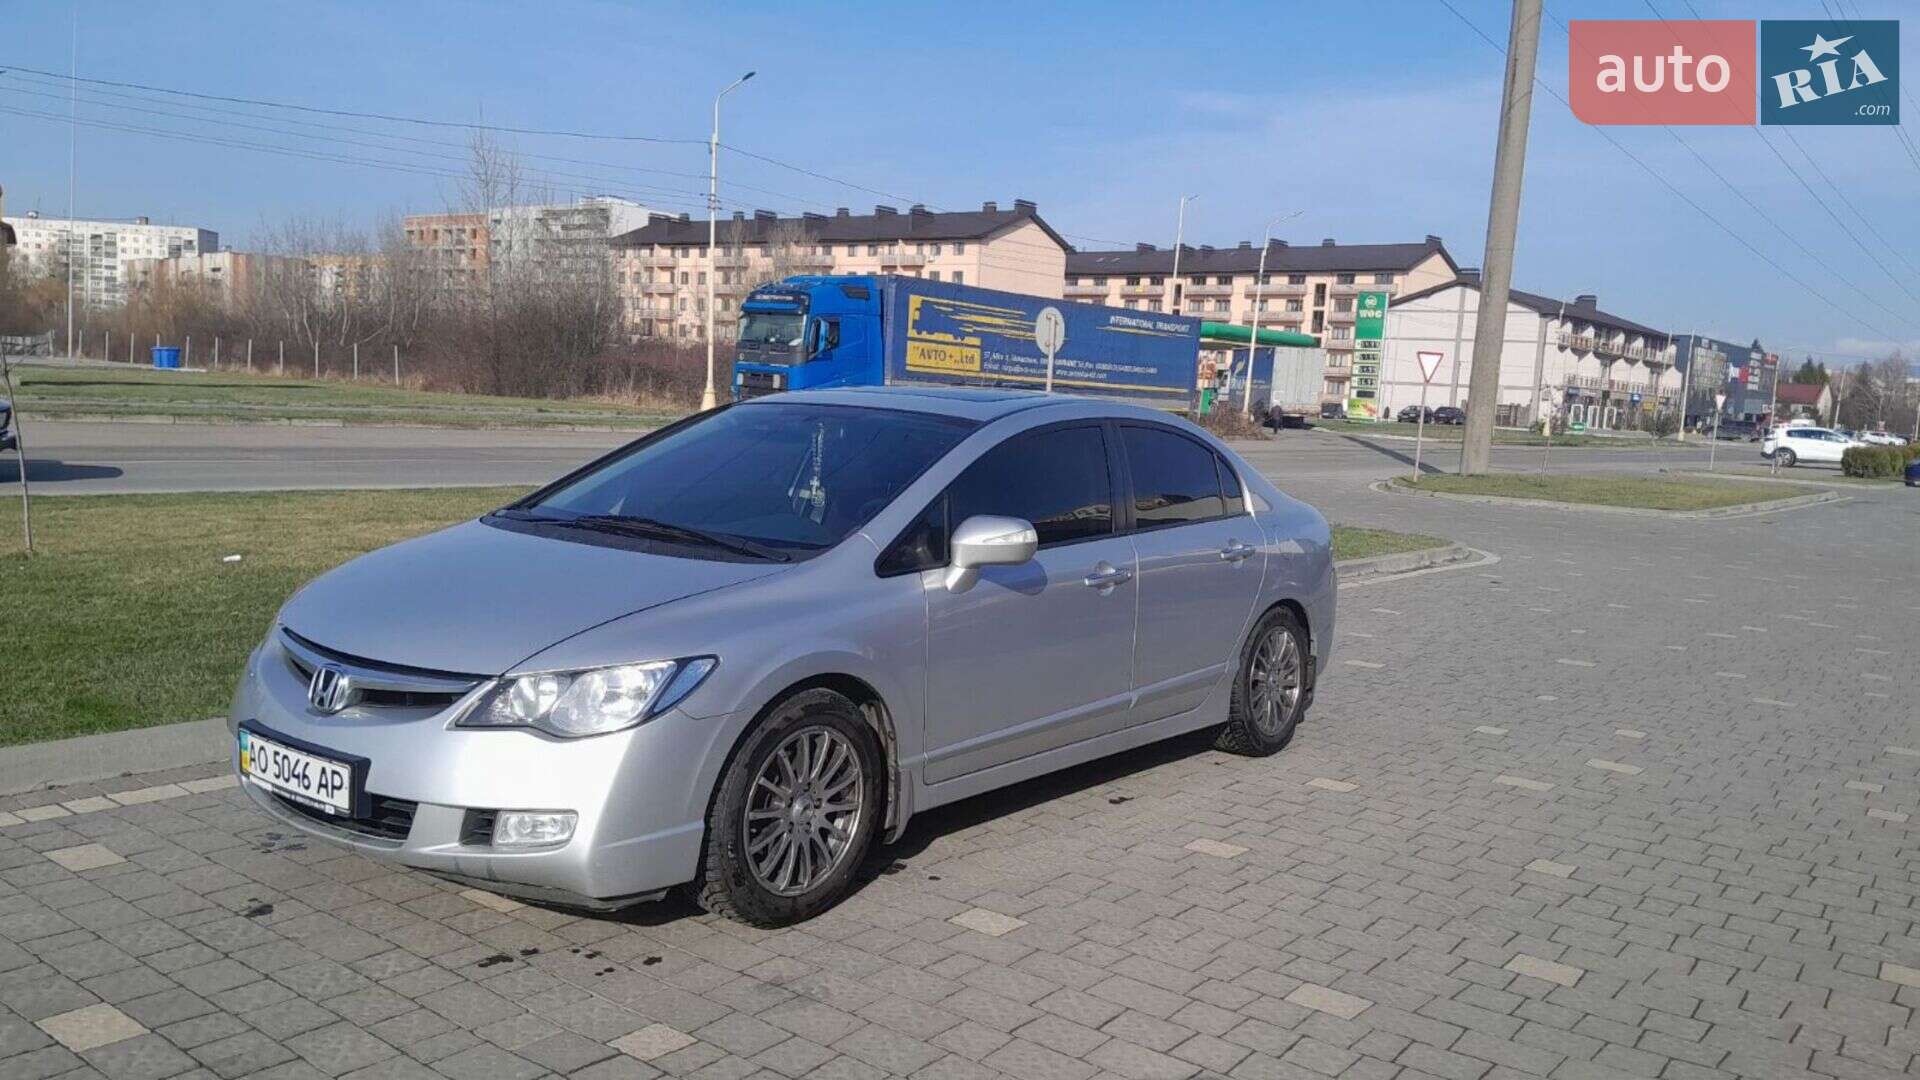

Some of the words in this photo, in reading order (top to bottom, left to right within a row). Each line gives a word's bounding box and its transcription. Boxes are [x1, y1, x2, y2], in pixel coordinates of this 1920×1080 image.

[250, 741, 268, 774] AO
[273, 750, 311, 790] 5046
[317, 766, 344, 799] AP
